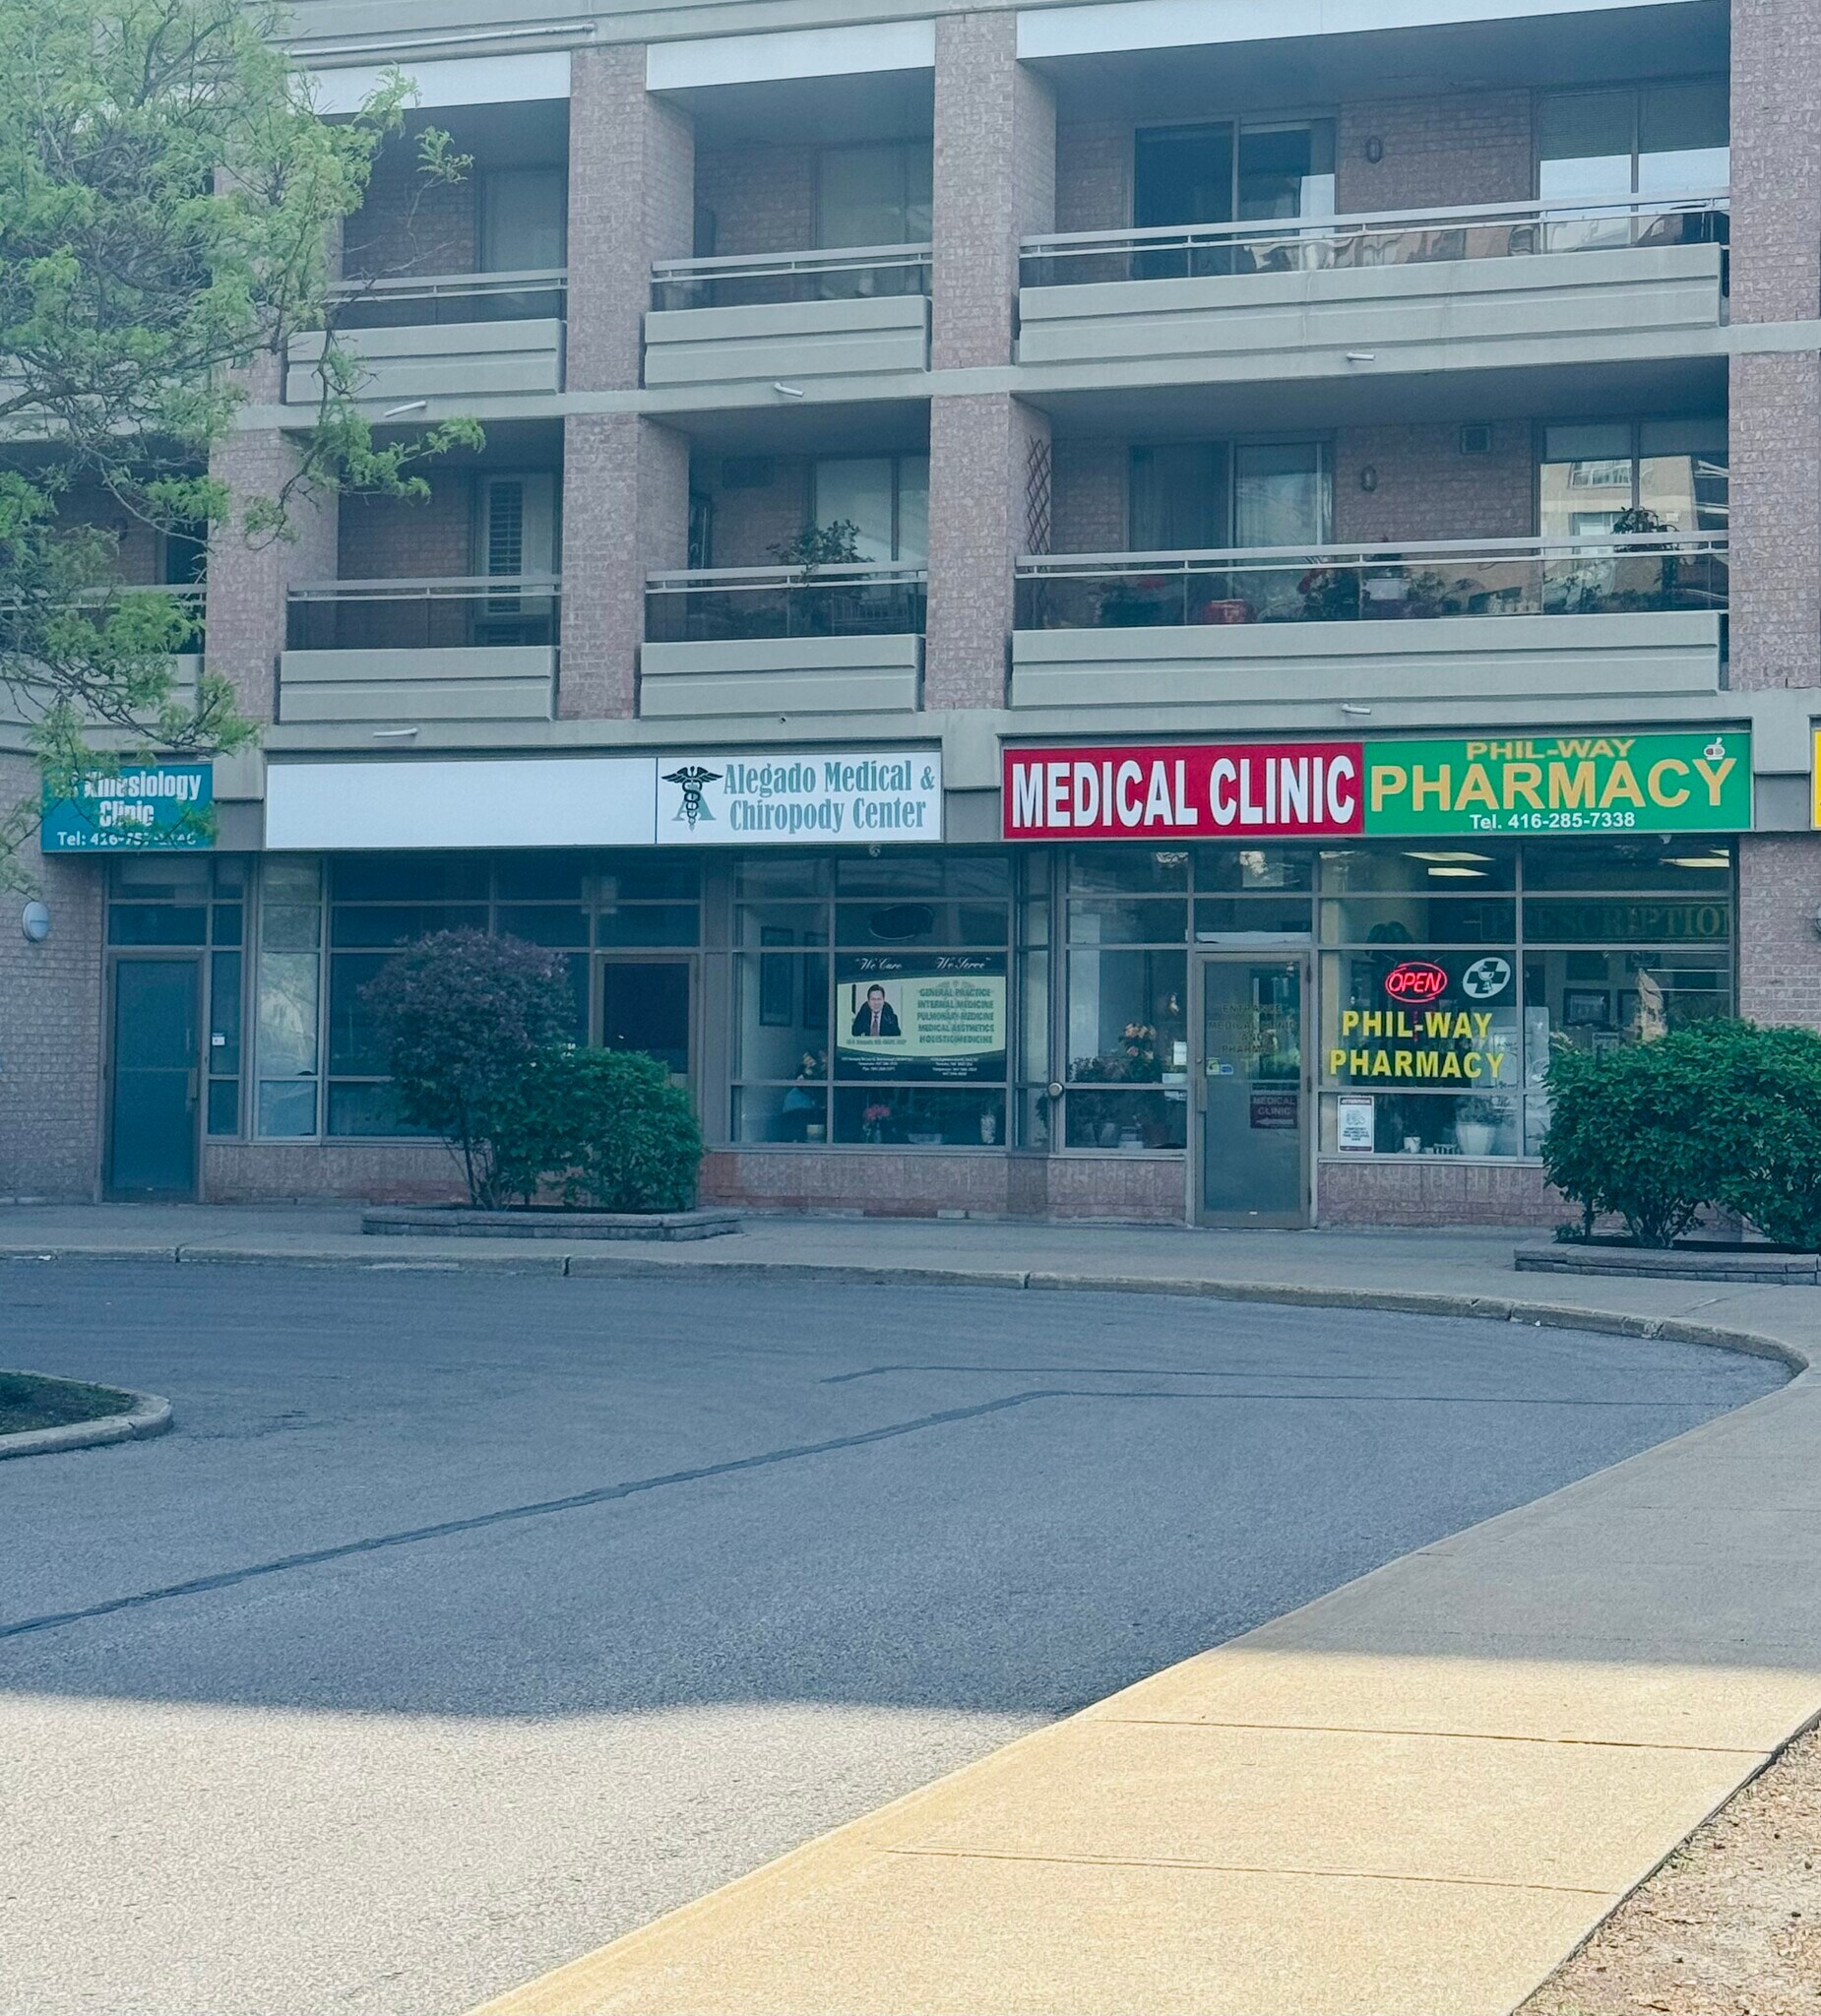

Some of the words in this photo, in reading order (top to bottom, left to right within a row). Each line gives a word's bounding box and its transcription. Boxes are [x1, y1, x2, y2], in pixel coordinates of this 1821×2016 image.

[1466, 739, 1636, 760] PHIL-WAY
[84, 771, 202, 800] Kinesiology
[723, 763, 816, 798] Alegado
[824, 760, 911, 792] Medical
[920, 766, 935, 790] &
[1012, 760, 1198, 827] MEDICAL
[1209, 755, 1354, 825] CLINIC
[1370, 757, 1736, 811] PHARMACY
[99, 800, 155, 827] Clinic
[729, 798, 845, 835] Chiropody
[852, 796, 926, 829] Center
[1470, 814, 1502, 830] Tel.
[1508, 812, 1635, 829] 416-285-7338
[57, 832, 86, 846] Tel:
[919, 988, 953, 997] GENERAL
[955, 988, 991, 997] PRACTICE
[1388, 972, 1443, 992] OPEN
[916, 1012, 959, 1021] PULMONARY
[961, 1012, 994, 1021] MEDICINE
[917, 1000, 955, 1009] INTERNAL
[957, 1000, 994, 1009] MEDICINE
[918, 1024, 950, 1033] MEDICAL
[1342, 1011, 1493, 1039] PHIL-WAY
[1330, 1049, 1505, 1078] PHARMACY
